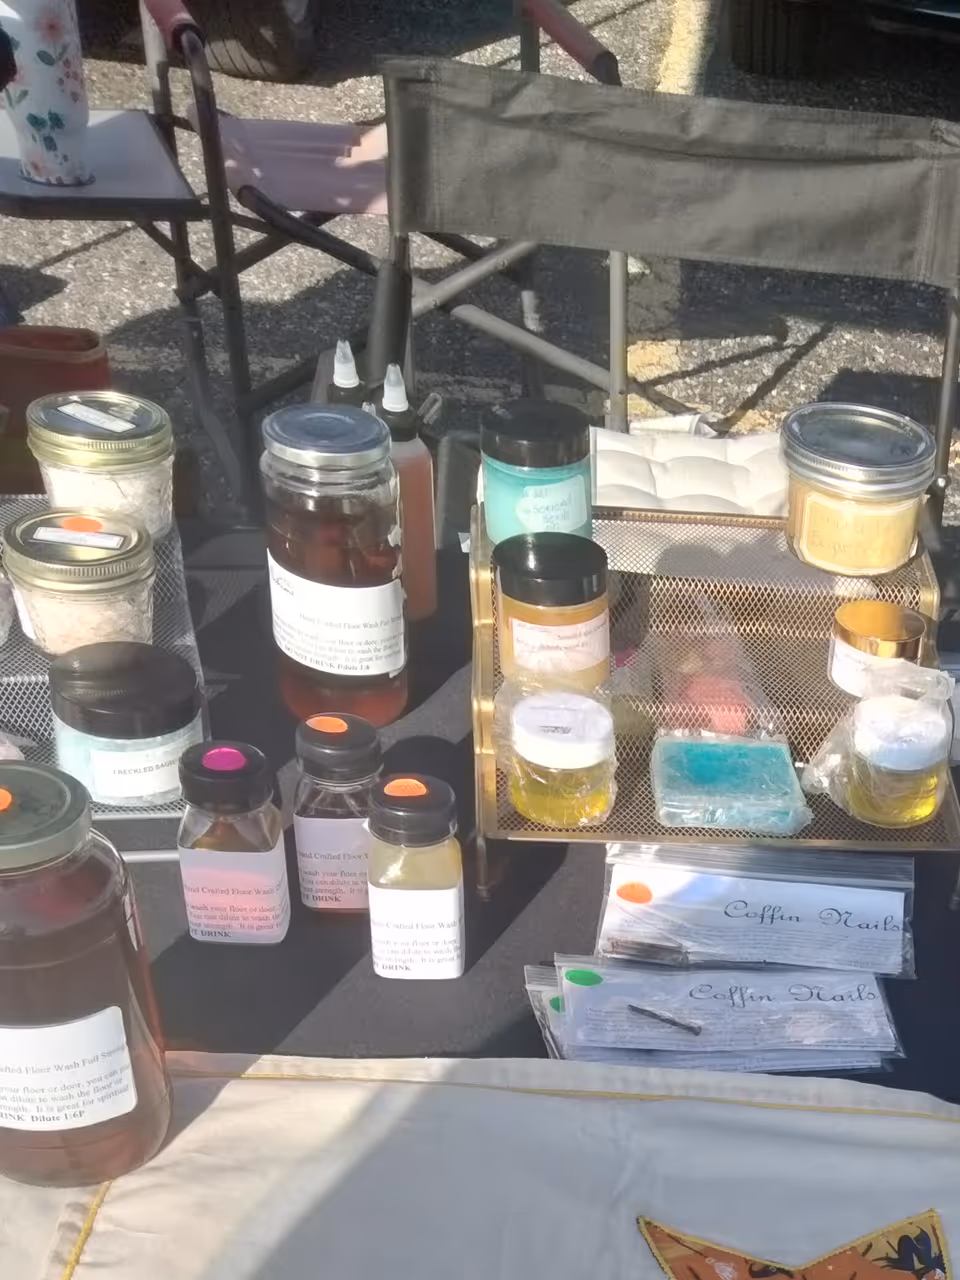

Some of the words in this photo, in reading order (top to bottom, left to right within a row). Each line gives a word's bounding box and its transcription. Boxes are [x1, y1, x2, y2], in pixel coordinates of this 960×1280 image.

[201, 886, 230, 895] Crafted
[312, 894, 341, 902] DRINK
[723, 899, 800, 925] Coffin
[818, 907, 902, 932] Nails
[200, 929, 233, 938] DRINK
[381, 963, 412, 971] DRINK
[688, 984, 773, 1008] Coffin
[788, 983, 880, 1003] Nails
[25, 1066, 51, 1075] Floor
[53, 1061, 80, 1072] Wash
[81, 1054, 99, 1067] Full
[0, 1112, 26, 1122] RINK
